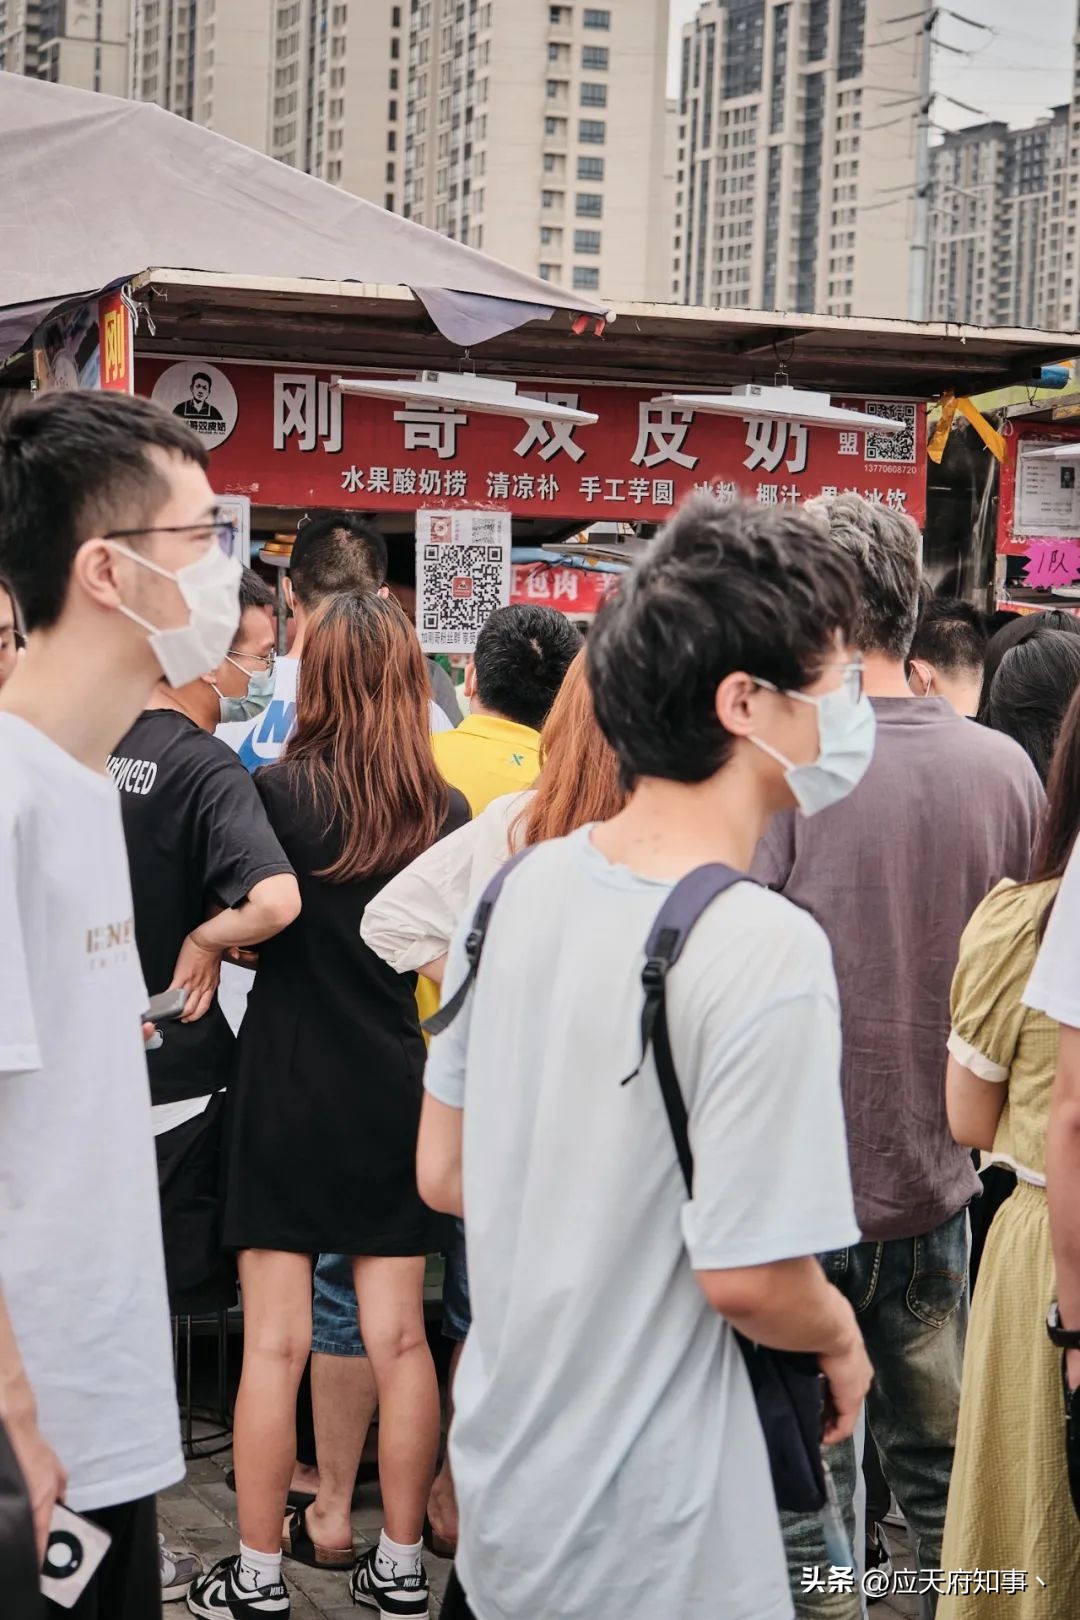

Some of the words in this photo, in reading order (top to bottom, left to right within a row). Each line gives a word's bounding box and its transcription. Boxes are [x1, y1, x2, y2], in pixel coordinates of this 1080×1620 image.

[104, 305, 125, 384] 刚
[341, 465, 467, 497] 水果酸奶捞
[486, 471, 559, 501] 清凉补
[579, 476, 674, 505] 手工芋圆
[403, 1578, 421, 1587] NIKE
